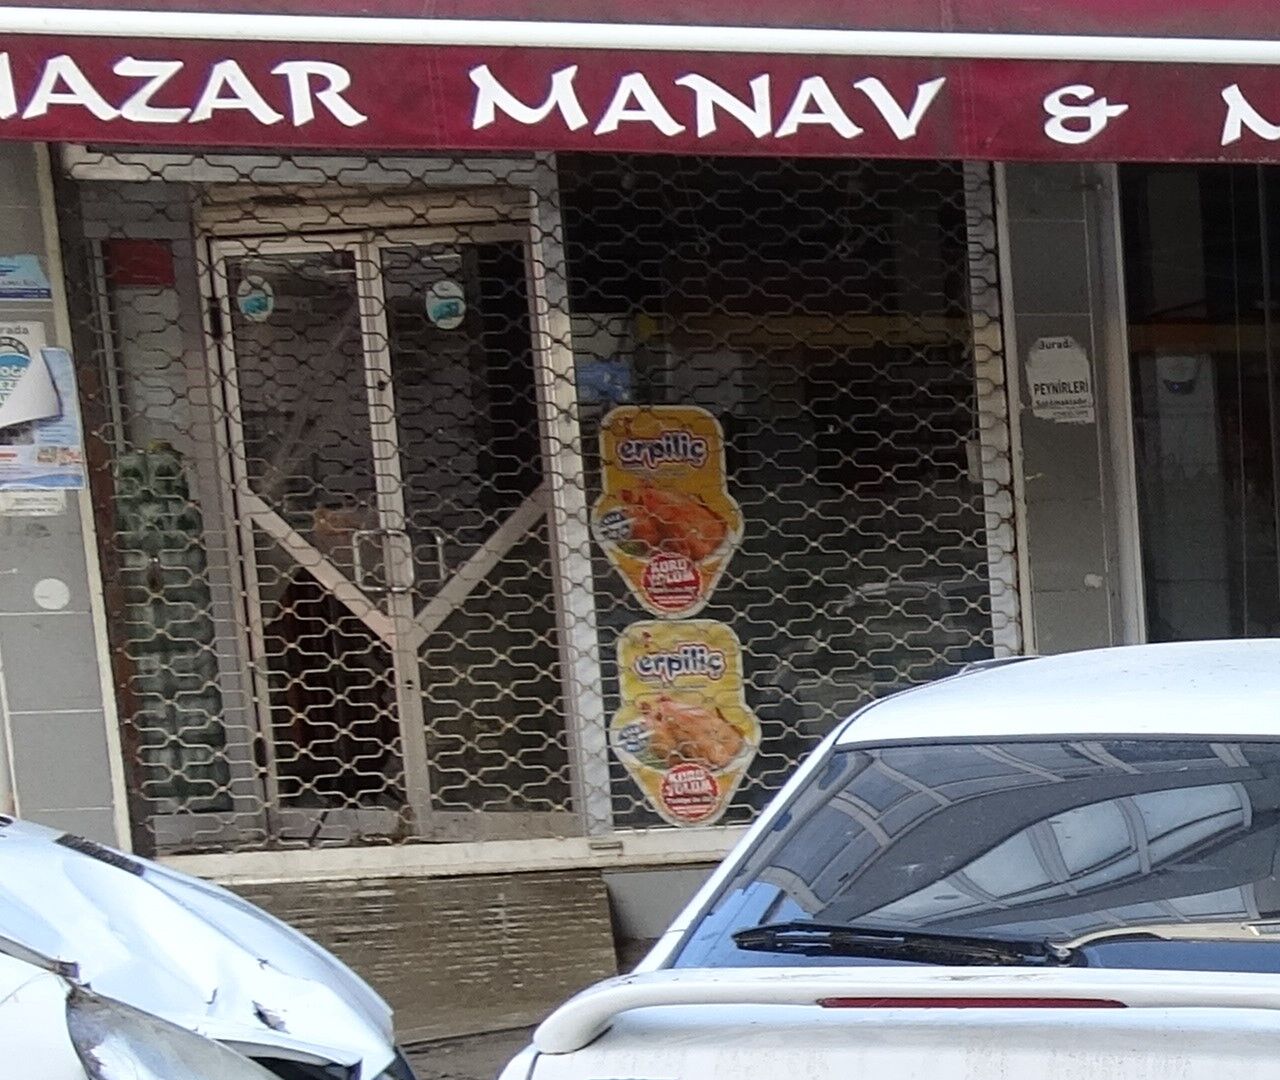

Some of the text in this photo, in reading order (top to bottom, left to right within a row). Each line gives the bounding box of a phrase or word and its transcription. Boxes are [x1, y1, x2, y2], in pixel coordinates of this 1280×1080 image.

[0, 50, 367, 128] AZAR
[469, 63, 946, 140] MANAV
[1043, 83, 1129, 144] &
